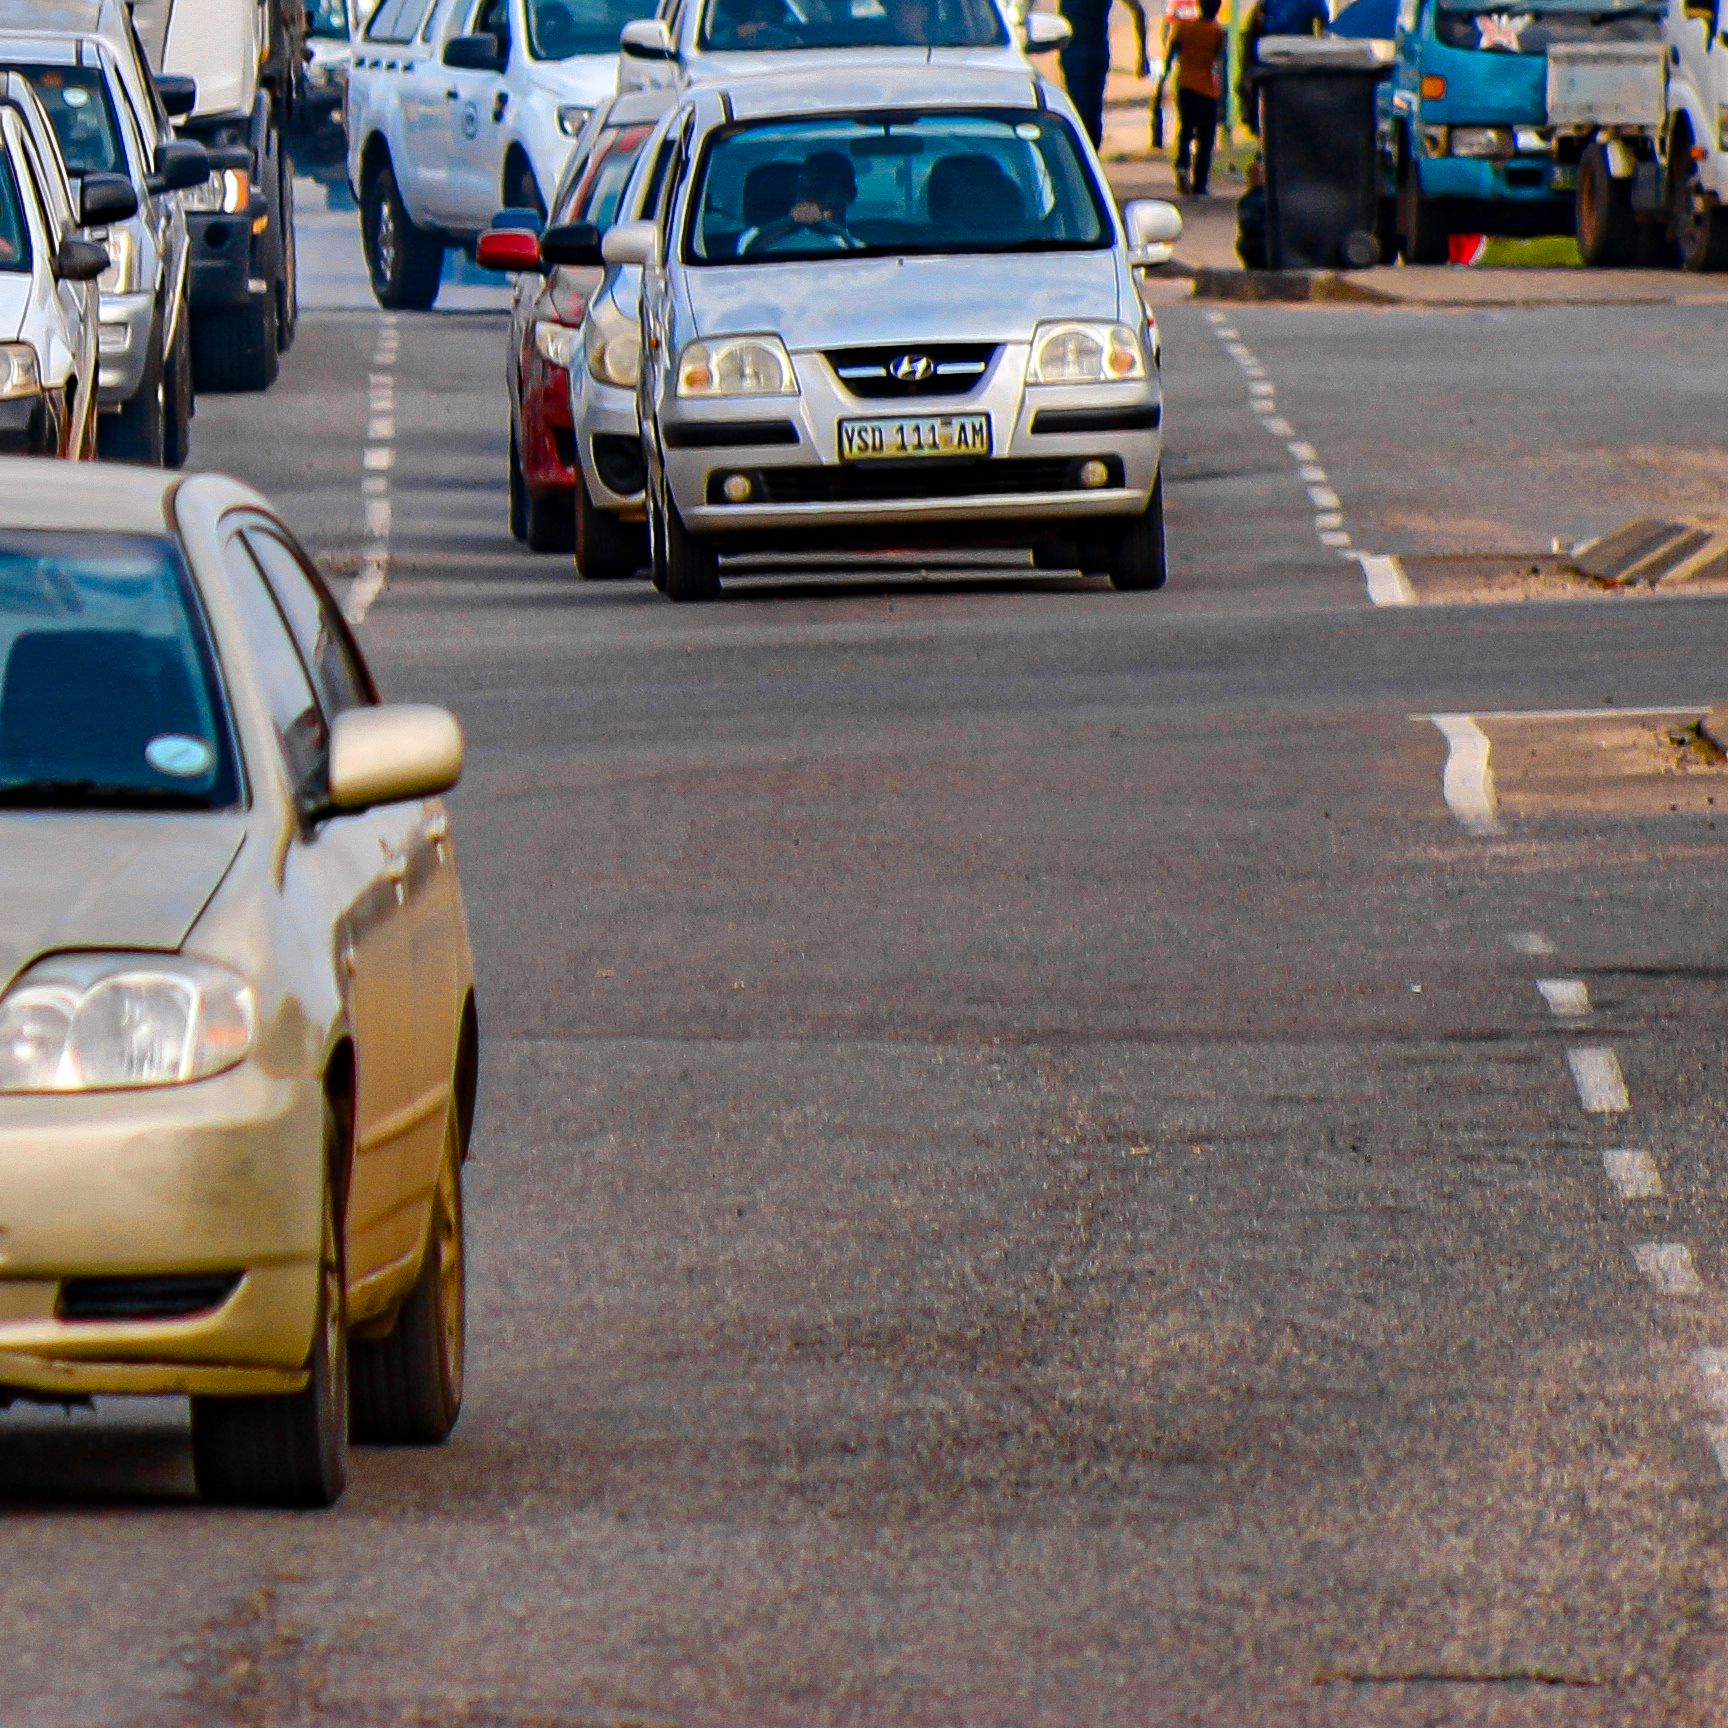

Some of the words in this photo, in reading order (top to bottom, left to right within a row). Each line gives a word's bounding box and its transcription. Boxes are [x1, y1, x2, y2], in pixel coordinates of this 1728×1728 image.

[844, 424, 884, 454] YSD
[897, 423, 940, 452] 111
[957, 421, 985, 449] AM
